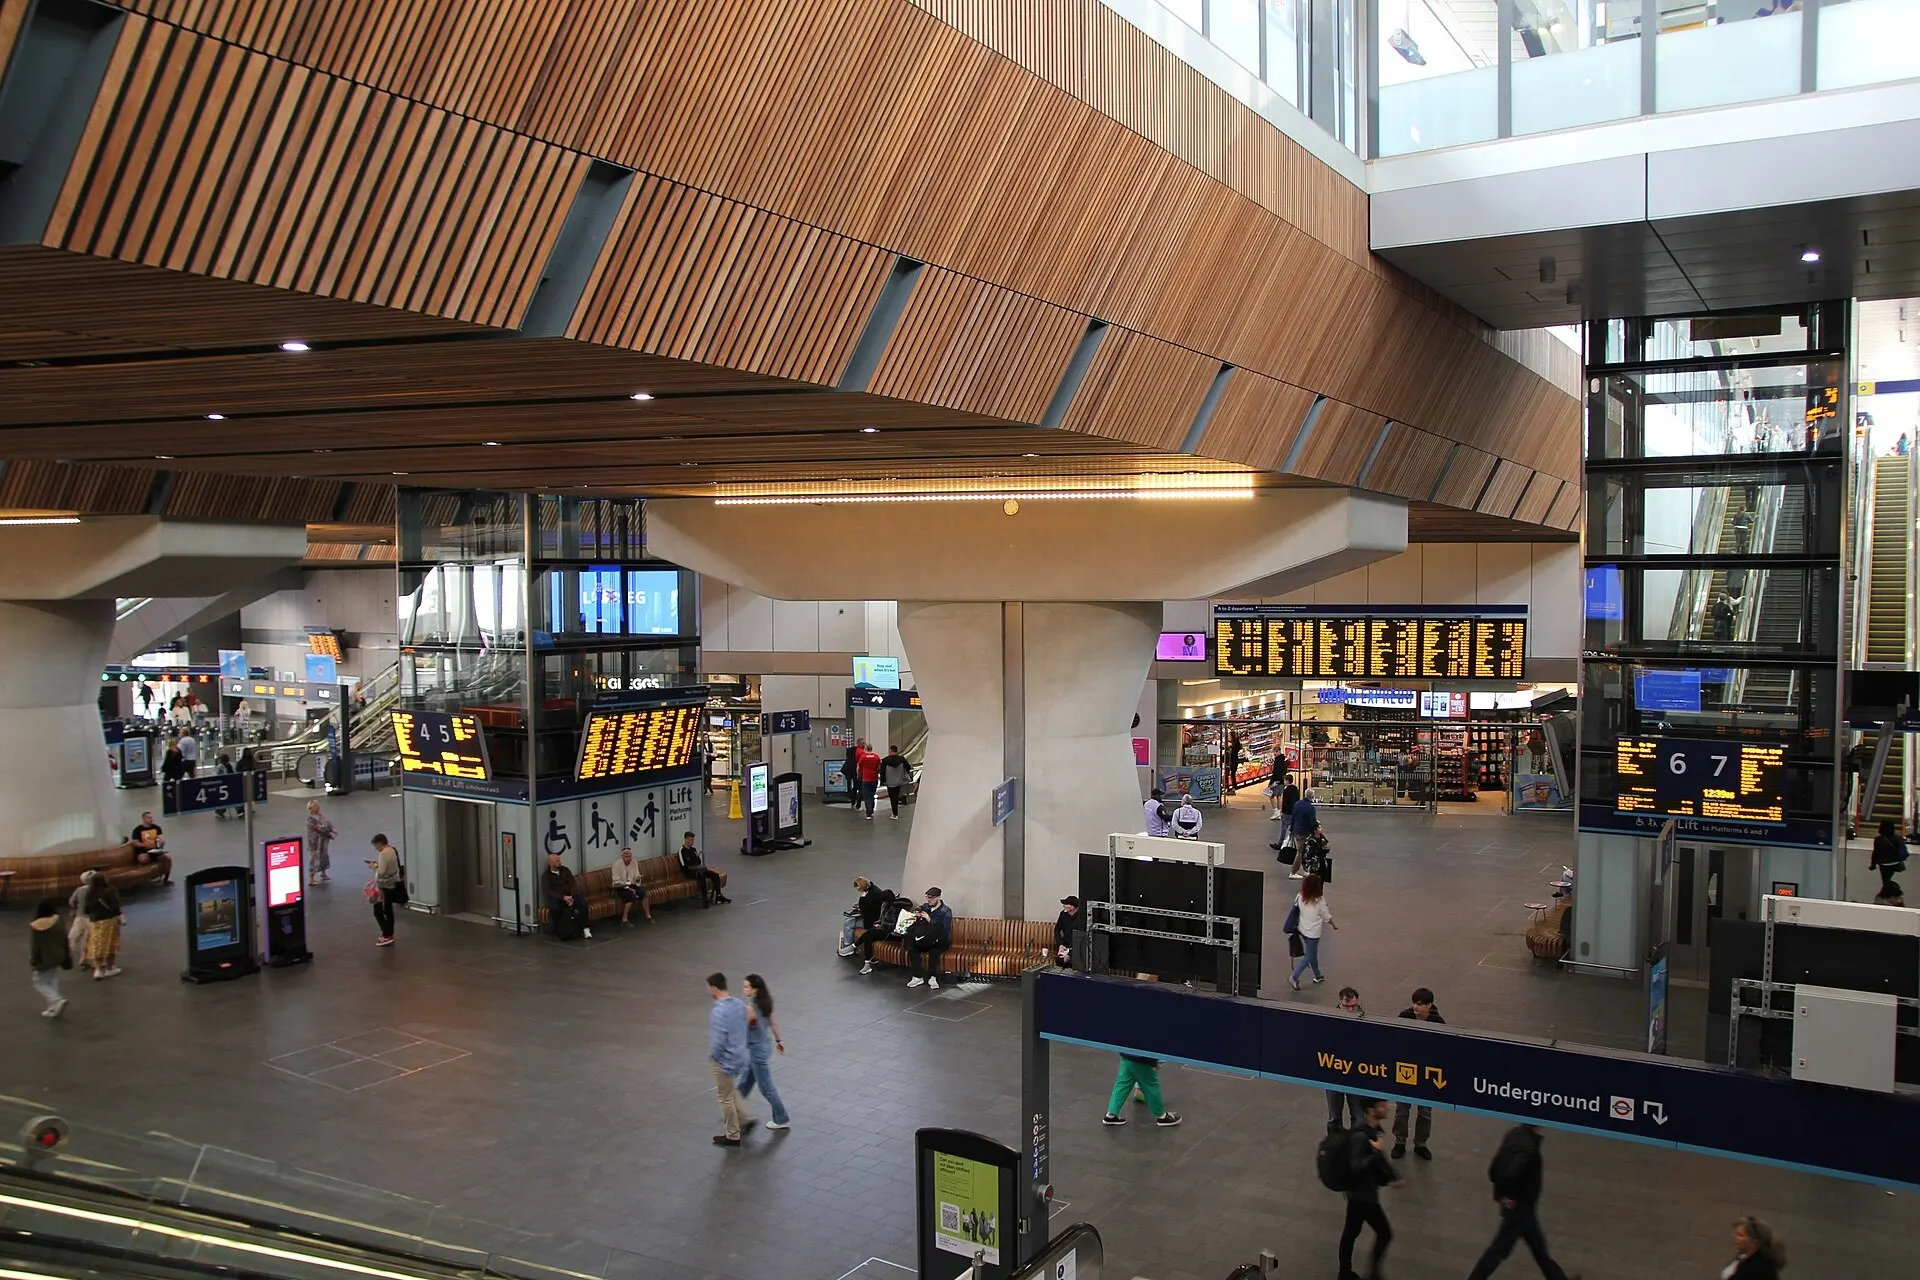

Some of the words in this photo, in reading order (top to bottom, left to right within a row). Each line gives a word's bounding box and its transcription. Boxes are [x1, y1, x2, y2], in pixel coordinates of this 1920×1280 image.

[1361, 688, 1414, 704] EXPRESS
[780, 718, 786, 729] 4
[790, 717, 796, 728] 5
[420, 723, 430, 741] 4
[439, 724, 450, 743] 5
[1669, 752, 1687, 775] 6
[1710, 755, 1728, 777] 7
[195, 788, 208, 804] 4
[218, 785, 230, 801] 5
[670, 787, 692, 805] Lift
[1677, 819, 1699, 831] Lift
[1711, 825, 1743, 834] Platforms
[1317, 1051, 1353, 1075] Way
[1357, 1061, 1388, 1079] out
[1473, 1077, 1601, 1113] Underground
